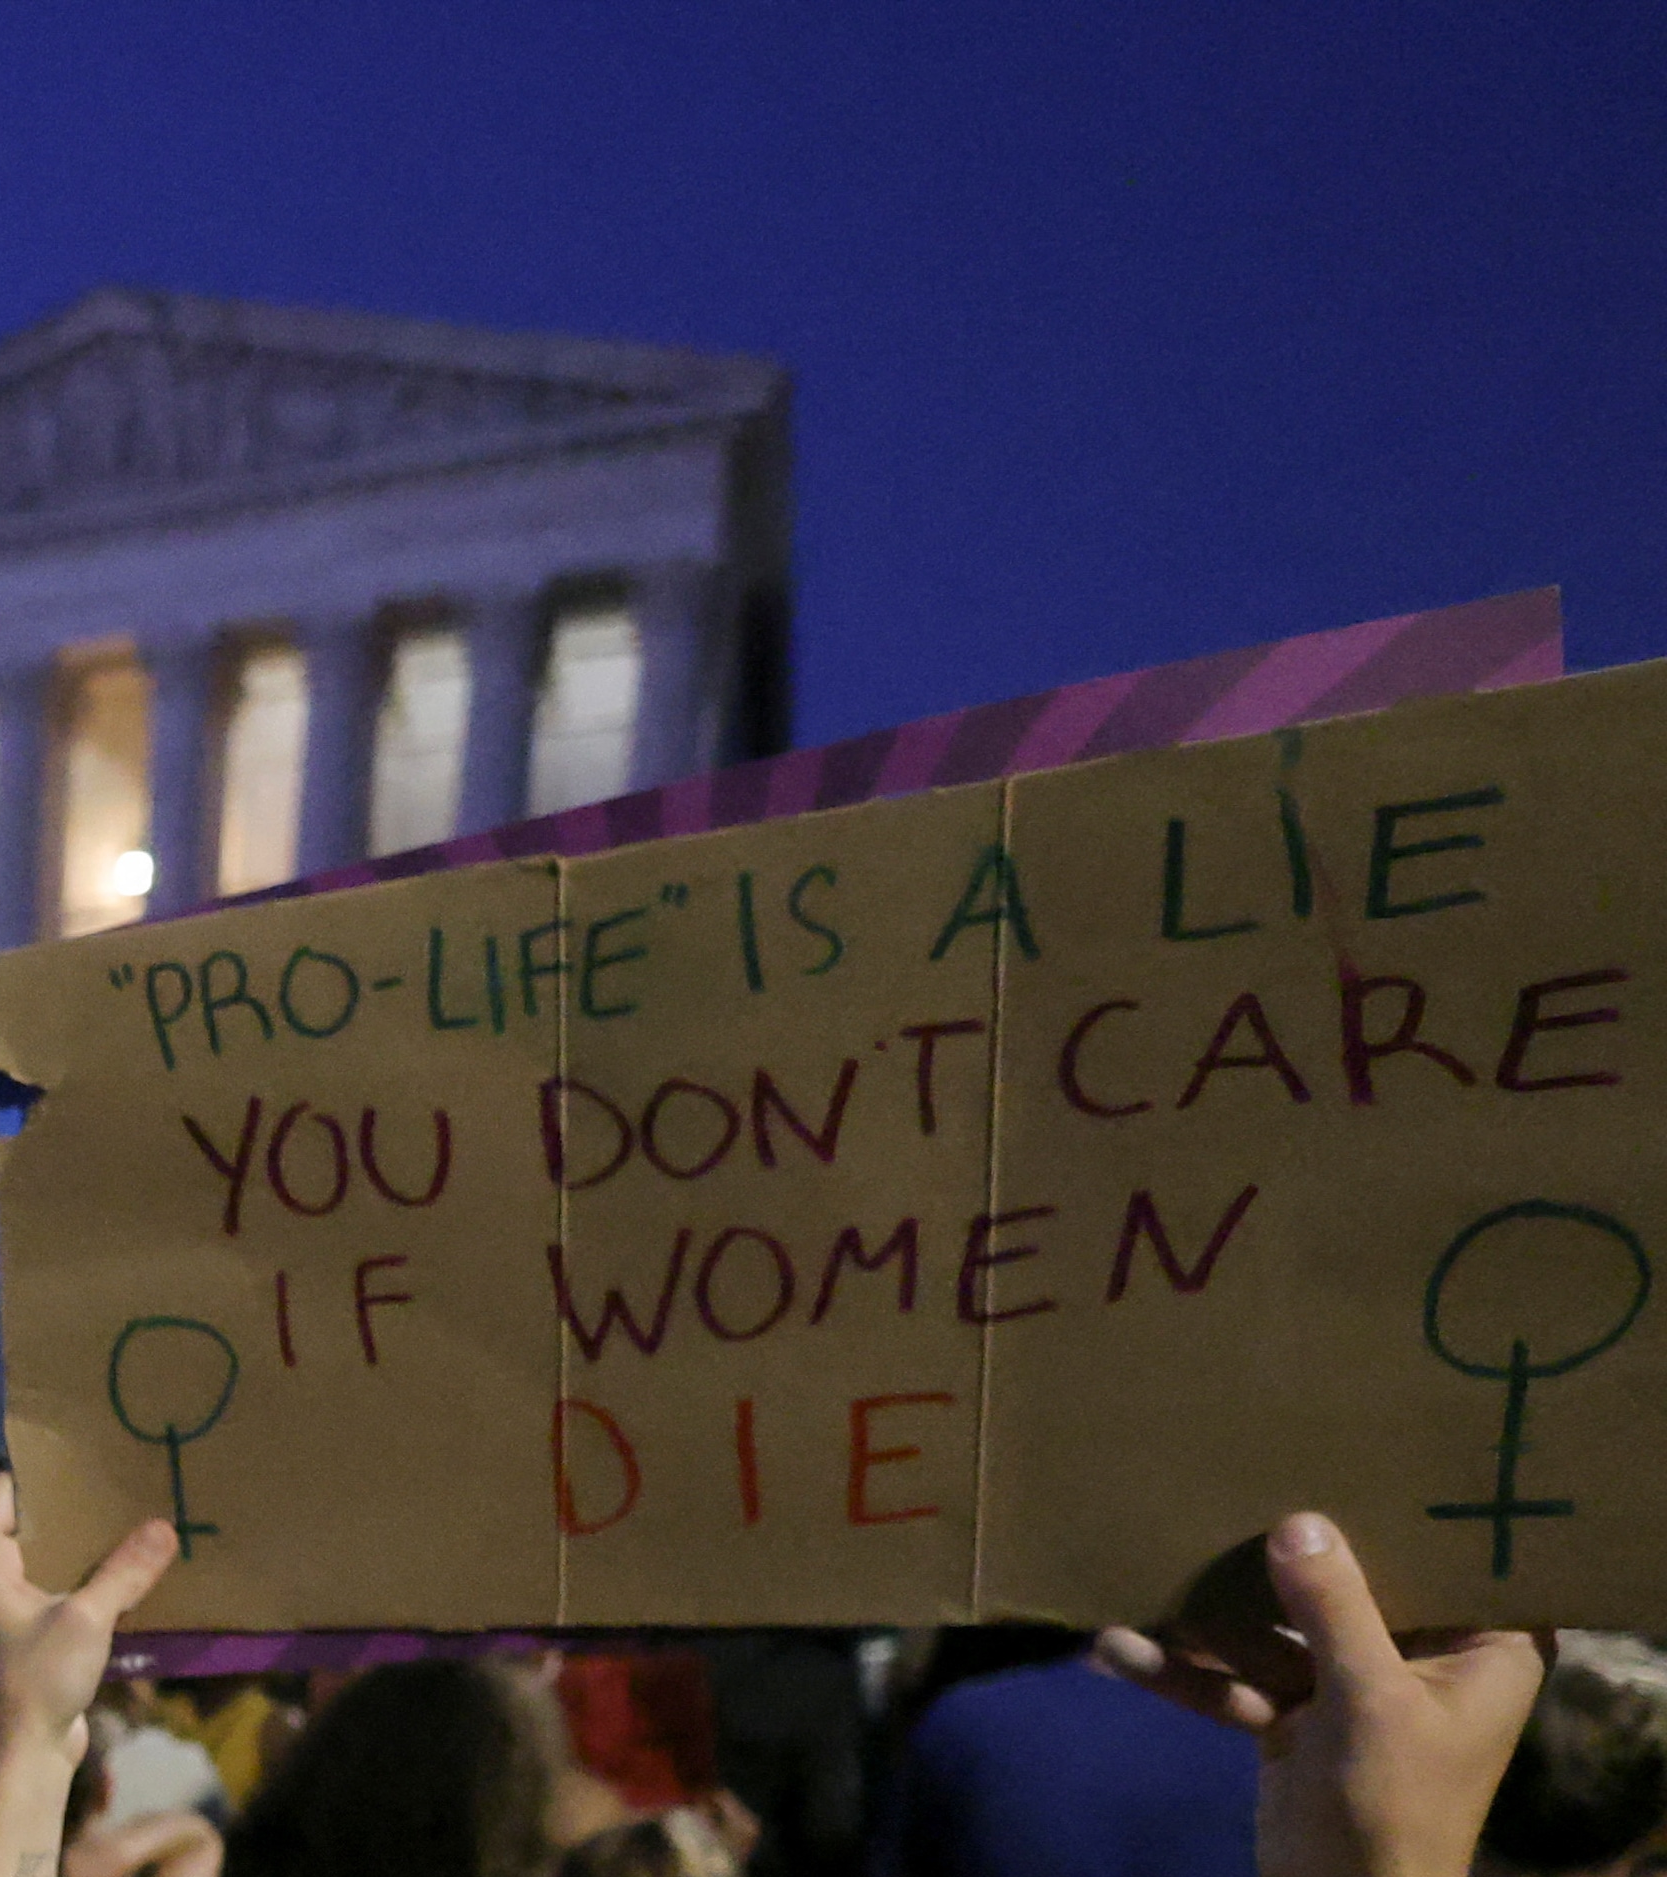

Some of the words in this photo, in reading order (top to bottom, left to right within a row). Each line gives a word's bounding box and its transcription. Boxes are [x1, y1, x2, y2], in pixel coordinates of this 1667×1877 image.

[110, 884, 688, 1070] "PRO-LIFE"
[739, 865, 844, 993] IS
[929, 843, 1041, 963] A
[1160, 735, 1504, 942] LIE
[181, 1097, 452, 1236] YOU
[539, 1019, 986, 1191] DON'T
[1059, 967, 1630, 1118] CARE
[276, 1254, 414, 1369] IF
[546, 1184, 1260, 1363] WOMEN
[551, 1391, 956, 1537] DIE
